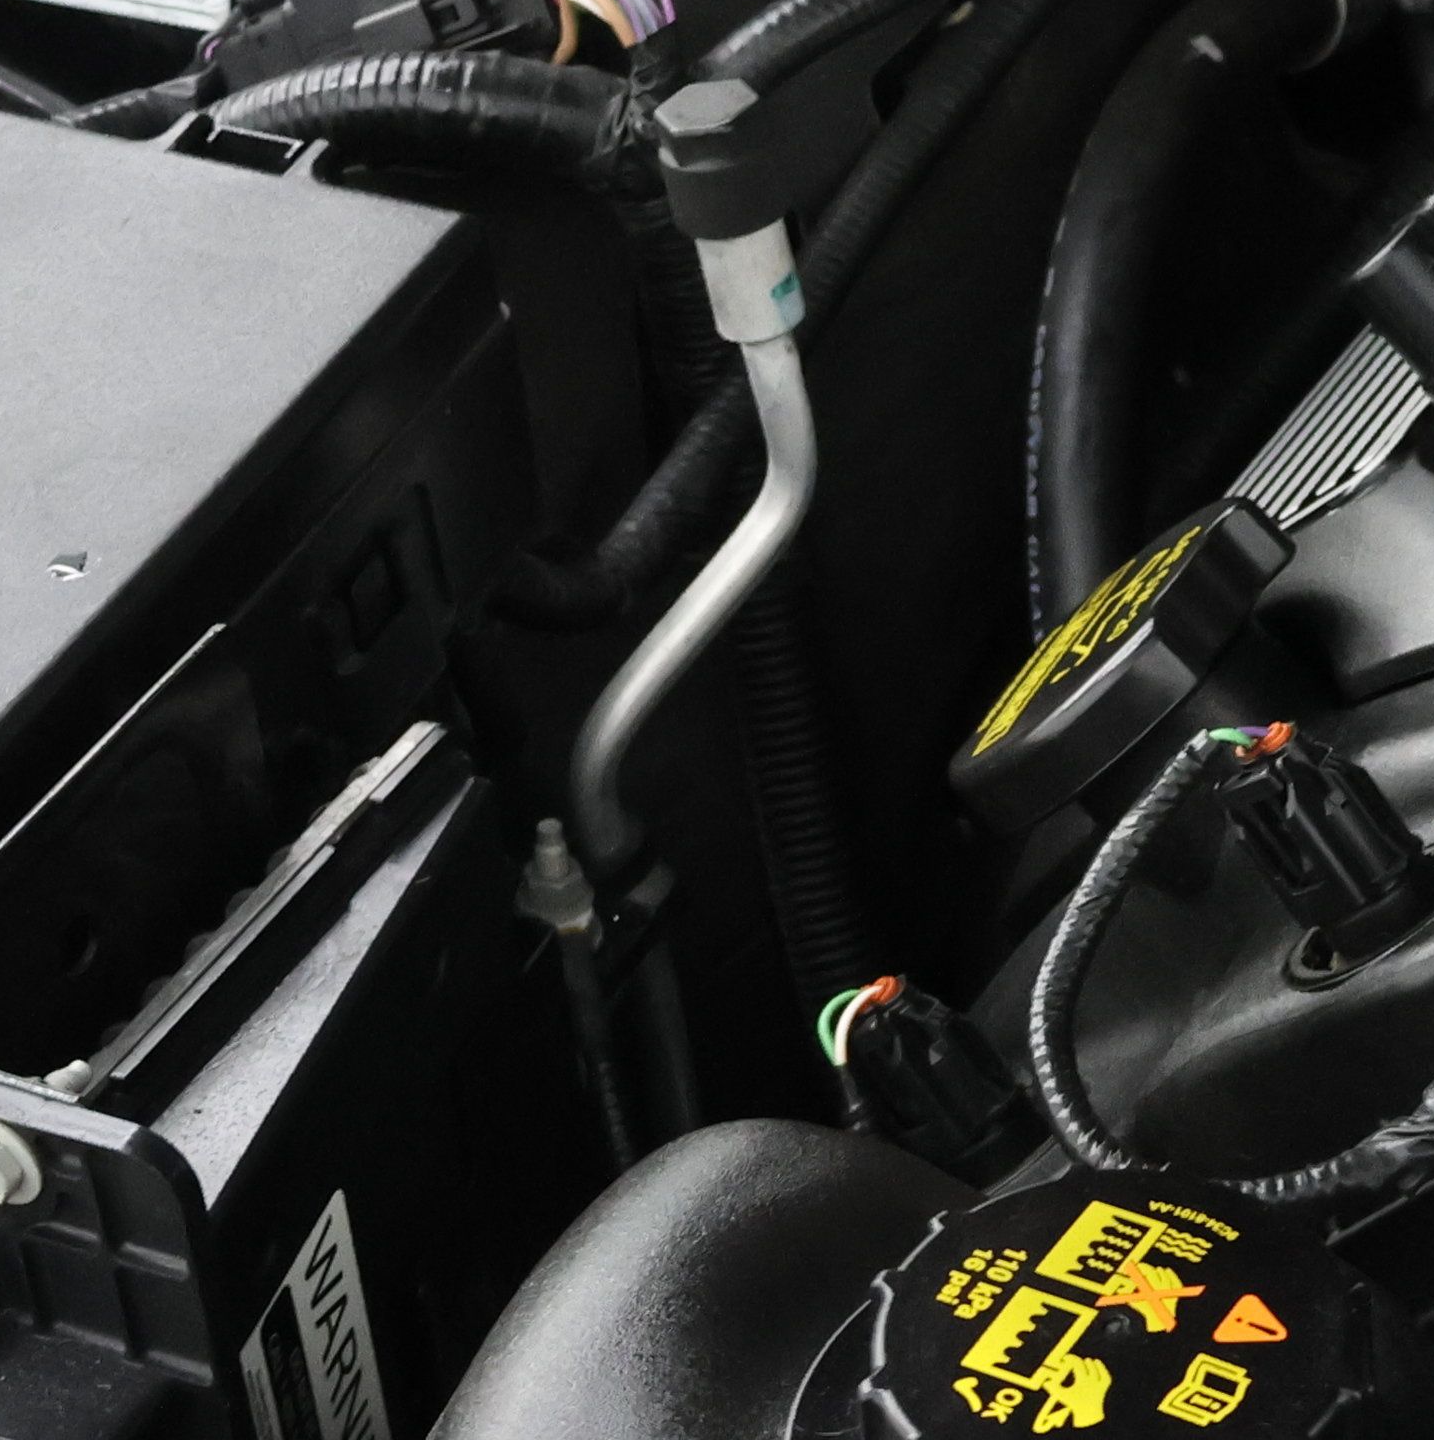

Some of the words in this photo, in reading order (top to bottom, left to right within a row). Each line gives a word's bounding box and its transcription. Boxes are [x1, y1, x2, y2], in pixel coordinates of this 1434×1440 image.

[963, 1248, 994, 1272] 16
[986, 1248, 1029, 1283] 110
[935, 1269, 972, 1306] psi
[953, 1281, 1003, 1320] kPa
[980, 1387, 1024, 1424] OK
